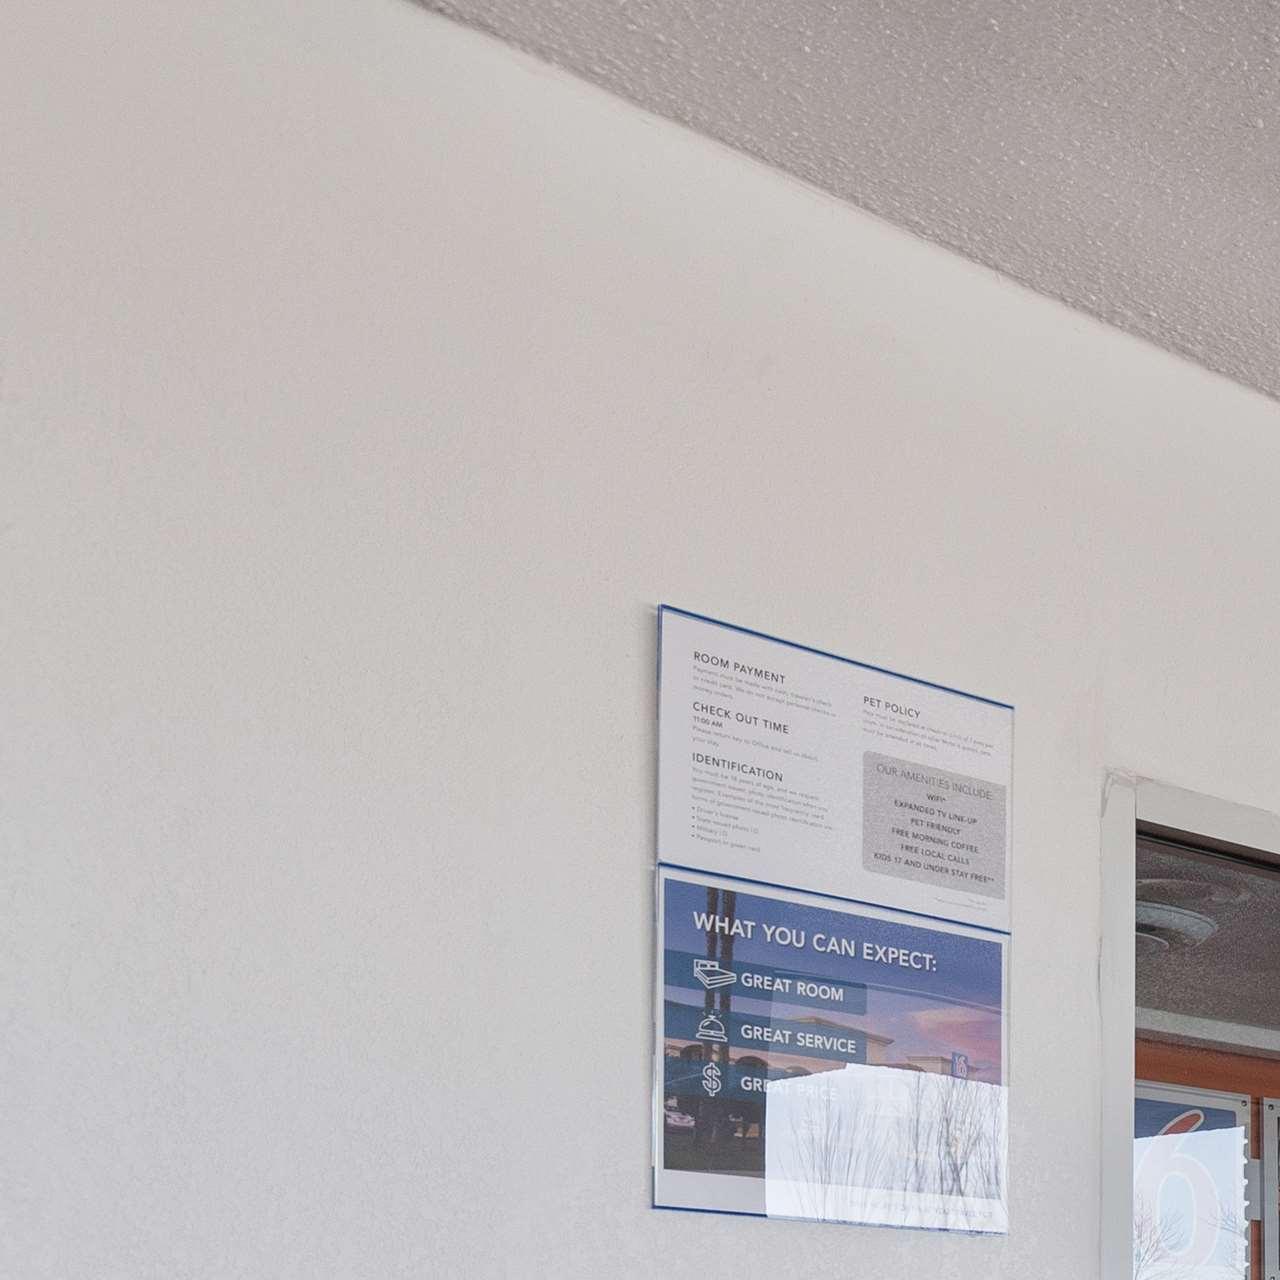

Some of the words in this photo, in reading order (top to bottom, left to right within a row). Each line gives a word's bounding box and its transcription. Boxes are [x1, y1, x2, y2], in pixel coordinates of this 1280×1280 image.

[694, 650, 730, 669] ROOM
[733, 662, 786, 684] PAYMENT
[692, 701, 732, 720] CHECK
[735, 712, 759, 726] OUT
[762, 719, 789, 734] TIME
[863, 696, 881, 709] PET
[884, 701, 921, 719] POLICY
[692, 752, 783, 782] IDENTIFICATION
[876, 763, 898, 777] OUR
[901, 769, 950, 790] AMENITIES
[952, 782, 993, 800] INCLUDE
[894, 799, 935, 816] EXPANDED
[936, 809, 948, 818] TV
[891, 827, 909, 839] FREE
[911, 832, 949, 847] MORNING
[951, 841, 980, 854] COFFEE
[910, 818, 924, 827] PET
[926, 821, 961, 836] FRIENDLY
[873, 852, 892, 862] KIDS
[904, 859, 922, 869] AND
[922, 861, 949, 875] UNDER
[951, 868, 969, 879] STAY
[900, 843, 919, 855] FREE
[921, 848, 945, 860] LOCAL
[947, 854, 970, 865] CALLS
[693, 911, 756, 940] WHAT
[762, 924, 806, 949] YOU
[812, 933, 856, 958] CAN
[863, 943, 938, 972] EXPECT:
[741, 973, 792, 993] GREAT
[796, 982, 844, 1002] ROOM
[740, 1024, 792, 1044] GREAT
[796, 1032, 857, 1054] SERVICE
